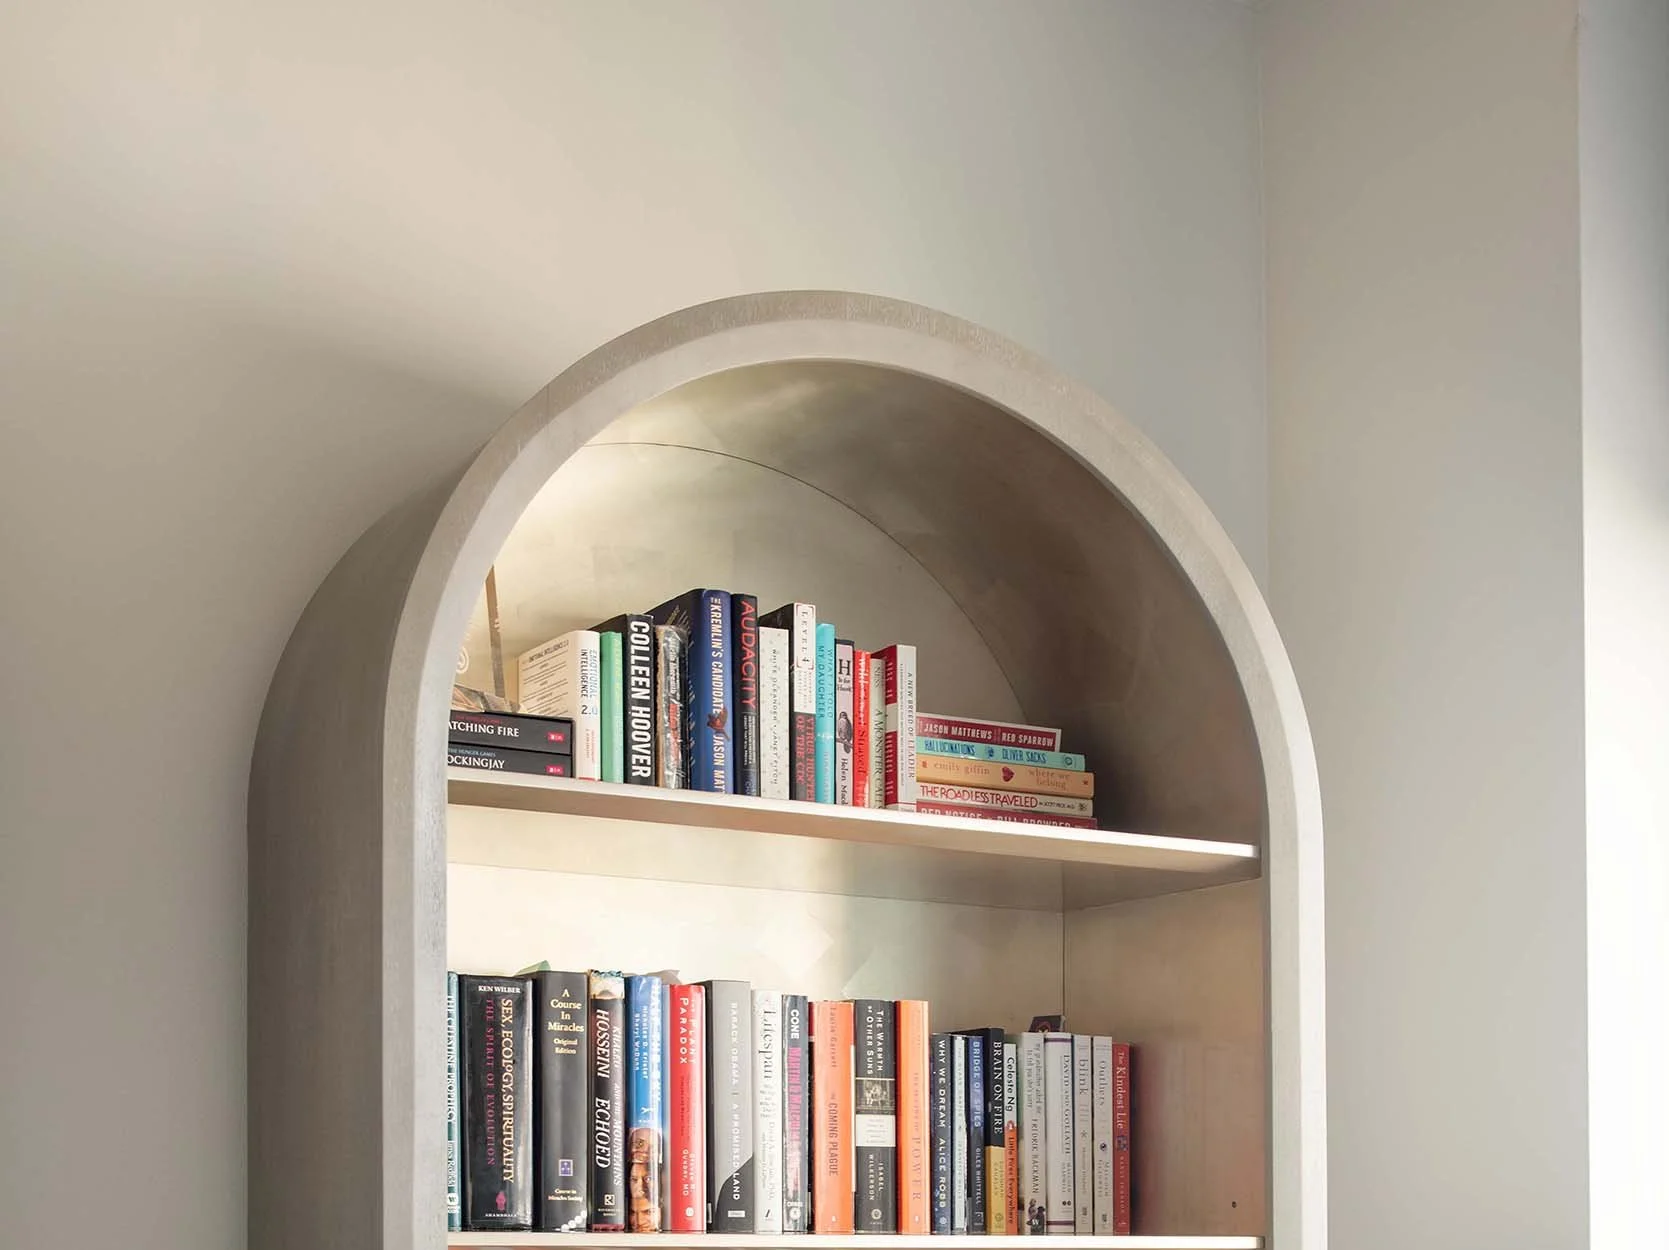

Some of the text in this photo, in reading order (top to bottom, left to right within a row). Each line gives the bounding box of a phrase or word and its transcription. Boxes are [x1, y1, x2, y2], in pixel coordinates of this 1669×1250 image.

[711, 603, 724, 658] KREMLIN'S
[580, 649, 588, 698] INTELLIGENCE
[741, 601, 756, 709] AUDACITY
[838, 659, 852, 675] H
[630, 620, 652, 777] COLLEEN HOOVER
[712, 660, 725, 715] CANDIDATE
[818, 663, 826, 718] DAUGHTER
[497, 726, 520, 737] FIRE
[951, 727, 993, 740] MATTHEWS
[1018, 735, 1054, 746] SPARROW
[446, 755, 505, 769] OCKINGJAY
[989, 792, 1038, 808] TRAVELED
[479, 985, 522, 995] KEN WILBER
[550, 999, 583, 1010] Course
[562, 988, 570, 997] A
[548, 1022, 585, 1033] Miracles
[561, 1011, 571, 1020] In
[680, 997, 690, 1064] PARADOX
[790, 1009, 800, 1040] CONE
[596, 1009, 611, 1078] HOSSEINI
[759, 1010, 777, 1079] Lifespan
[876, 1033, 885, 1071] WARMTH
[938, 1040, 947, 1127] WHY WE DREAM
[993, 1041, 1004, 1135] BRAIN ON FIRE
[1006, 1057, 1016, 1113] Celeste Ng
[1079, 1058, 1089, 1095] blink
[595, 1096, 611, 1169] ECHOED
[829, 1103, 839, 1178] COMING PLAGUE
[733, 1172, 742, 1201] LAND
[939, 1138, 947, 1208] ALICE ROBB
